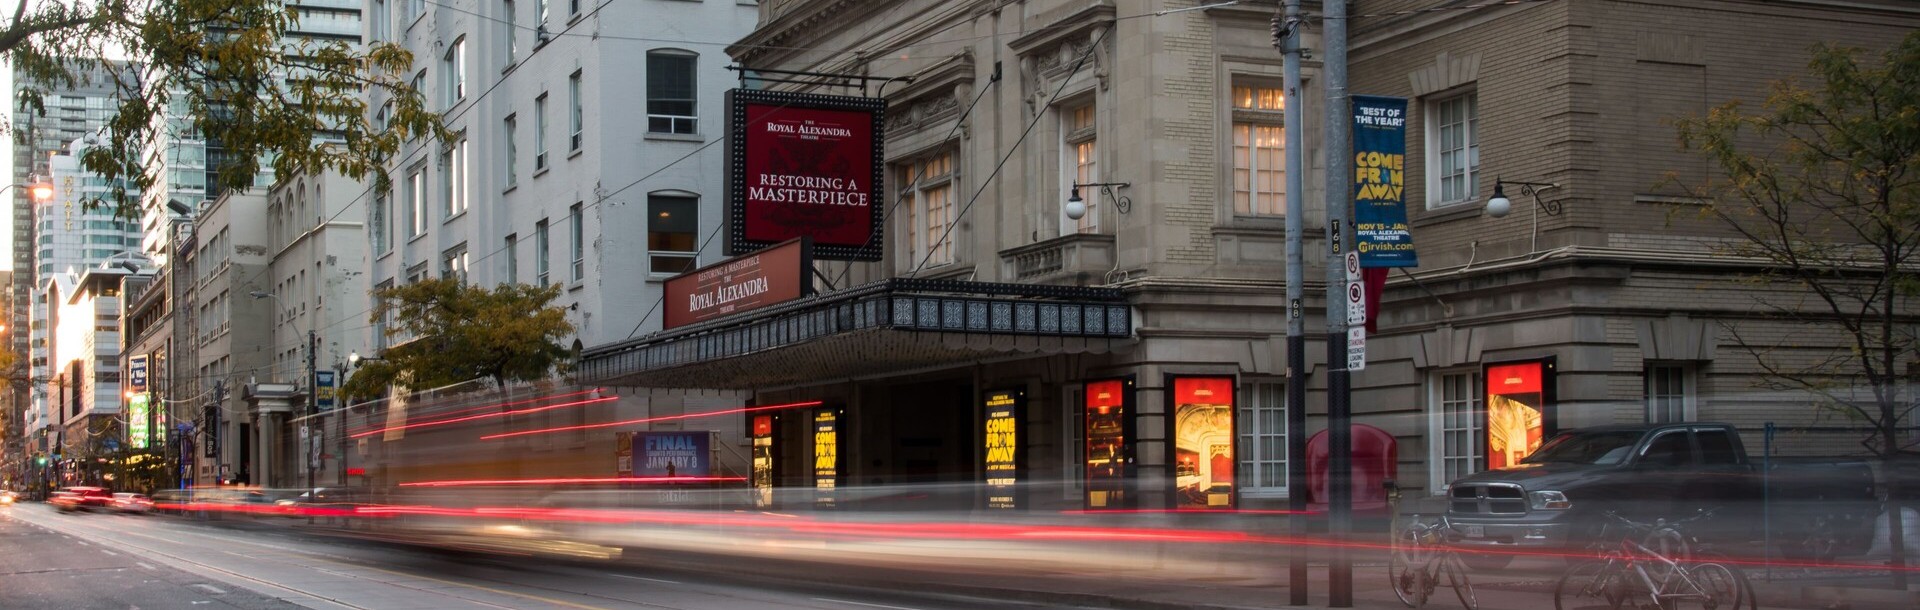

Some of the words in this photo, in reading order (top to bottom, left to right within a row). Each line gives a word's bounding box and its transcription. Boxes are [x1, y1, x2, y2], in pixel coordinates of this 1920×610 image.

[1355, 115, 1373, 124] THE
[1387, 109, 1400, 117] OF
[767, 122, 795, 133] ROYAL
[798, 125, 851, 137] ALEXANDRA
[1356, 151, 1404, 170] COME
[760, 174, 843, 190] RESTORING
[847, 179, 858, 190] A
[748, 187, 868, 206] MASTERPIECE
[1356, 183, 1403, 202] AWAY
[64, 175, 74, 231] HYATT
[728, 255, 760, 273] MASTERPIECE
[724, 275, 732, 283] THE
[690, 292, 715, 312] ROYAL
[716, 276, 768, 305] ALEXANDRA
[986, 418, 1015, 433] COME
[645, 435, 697, 450] FINAL
[816, 432, 836, 444] COME
[646, 456, 688, 469] JANUARY
[691, 456, 697, 469] 8
[986, 447, 1015, 463] AWAY
